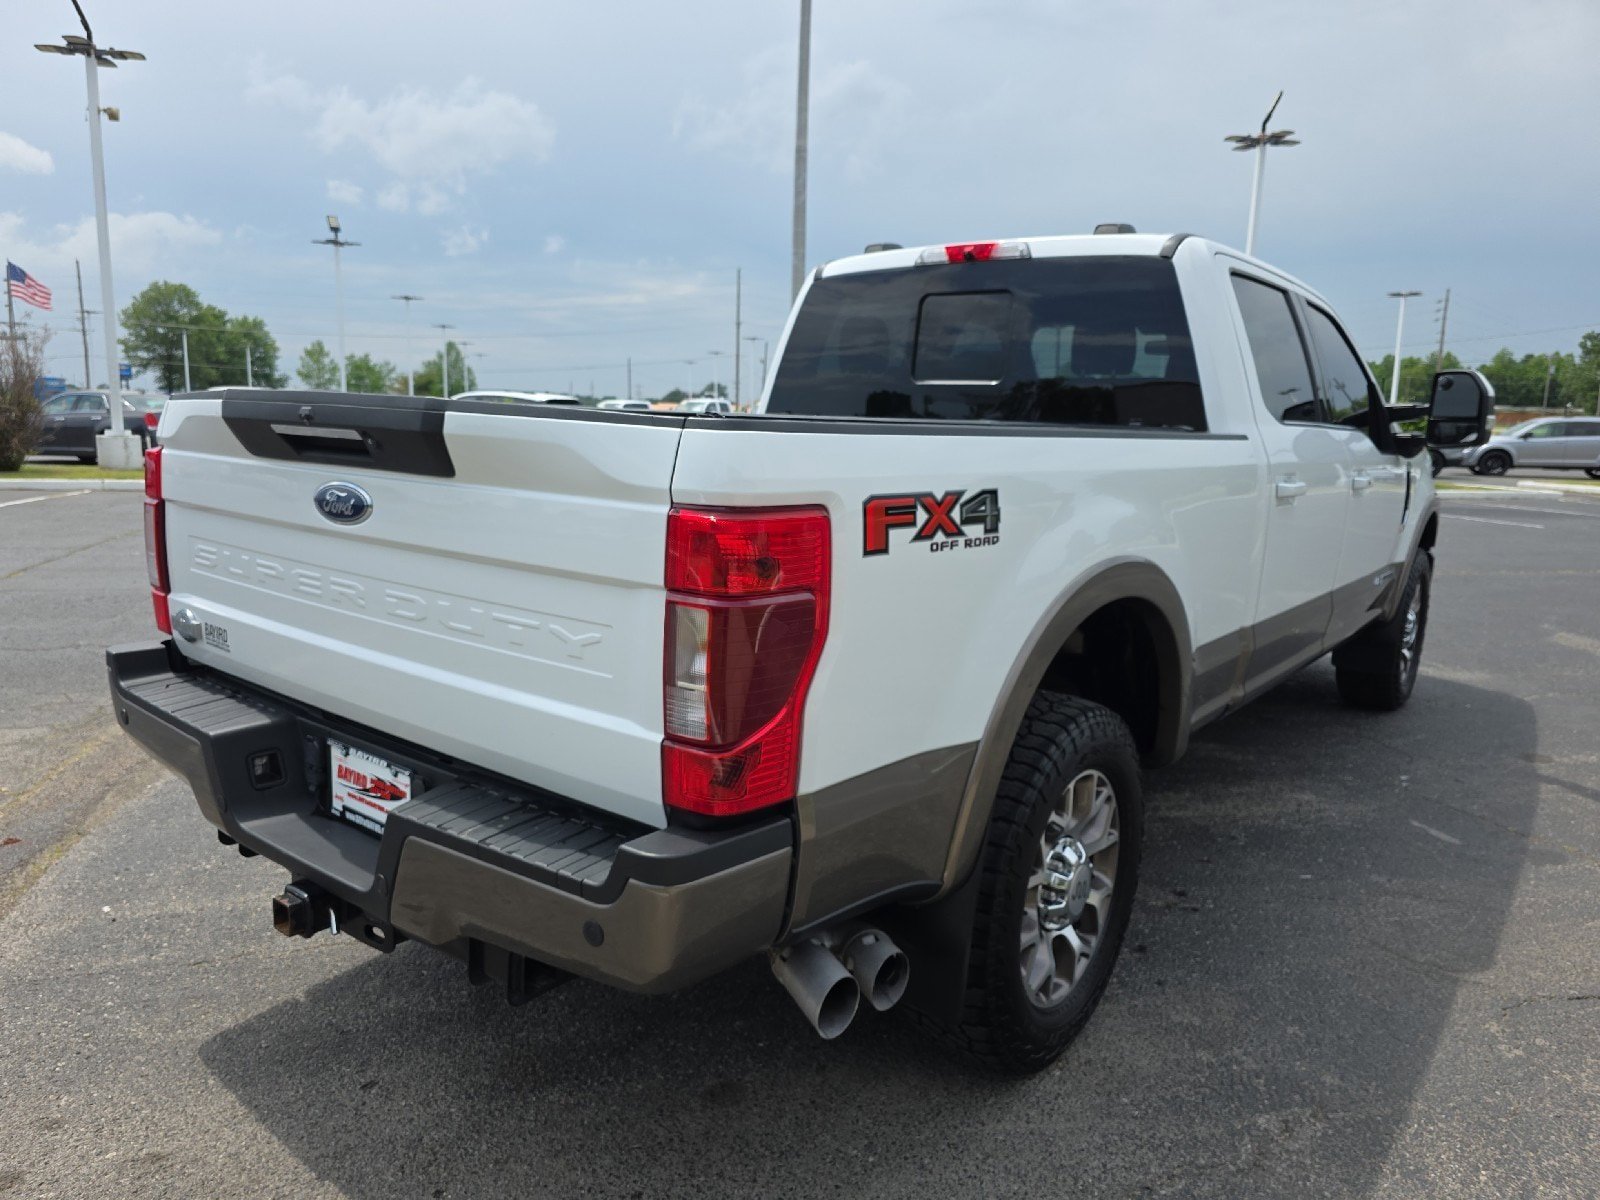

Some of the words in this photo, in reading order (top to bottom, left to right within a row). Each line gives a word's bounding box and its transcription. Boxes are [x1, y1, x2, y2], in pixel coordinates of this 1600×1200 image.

[322, 489, 356, 516] Ford
[863, 488, 1001, 558] FX4
[930, 540, 959, 553] OFF
[964, 536, 1000, 549] ROAD
[194, 544, 367, 611] SUPER
[384, 589, 603, 661] DUTY
[337, 764, 368, 789] BAYIRD
